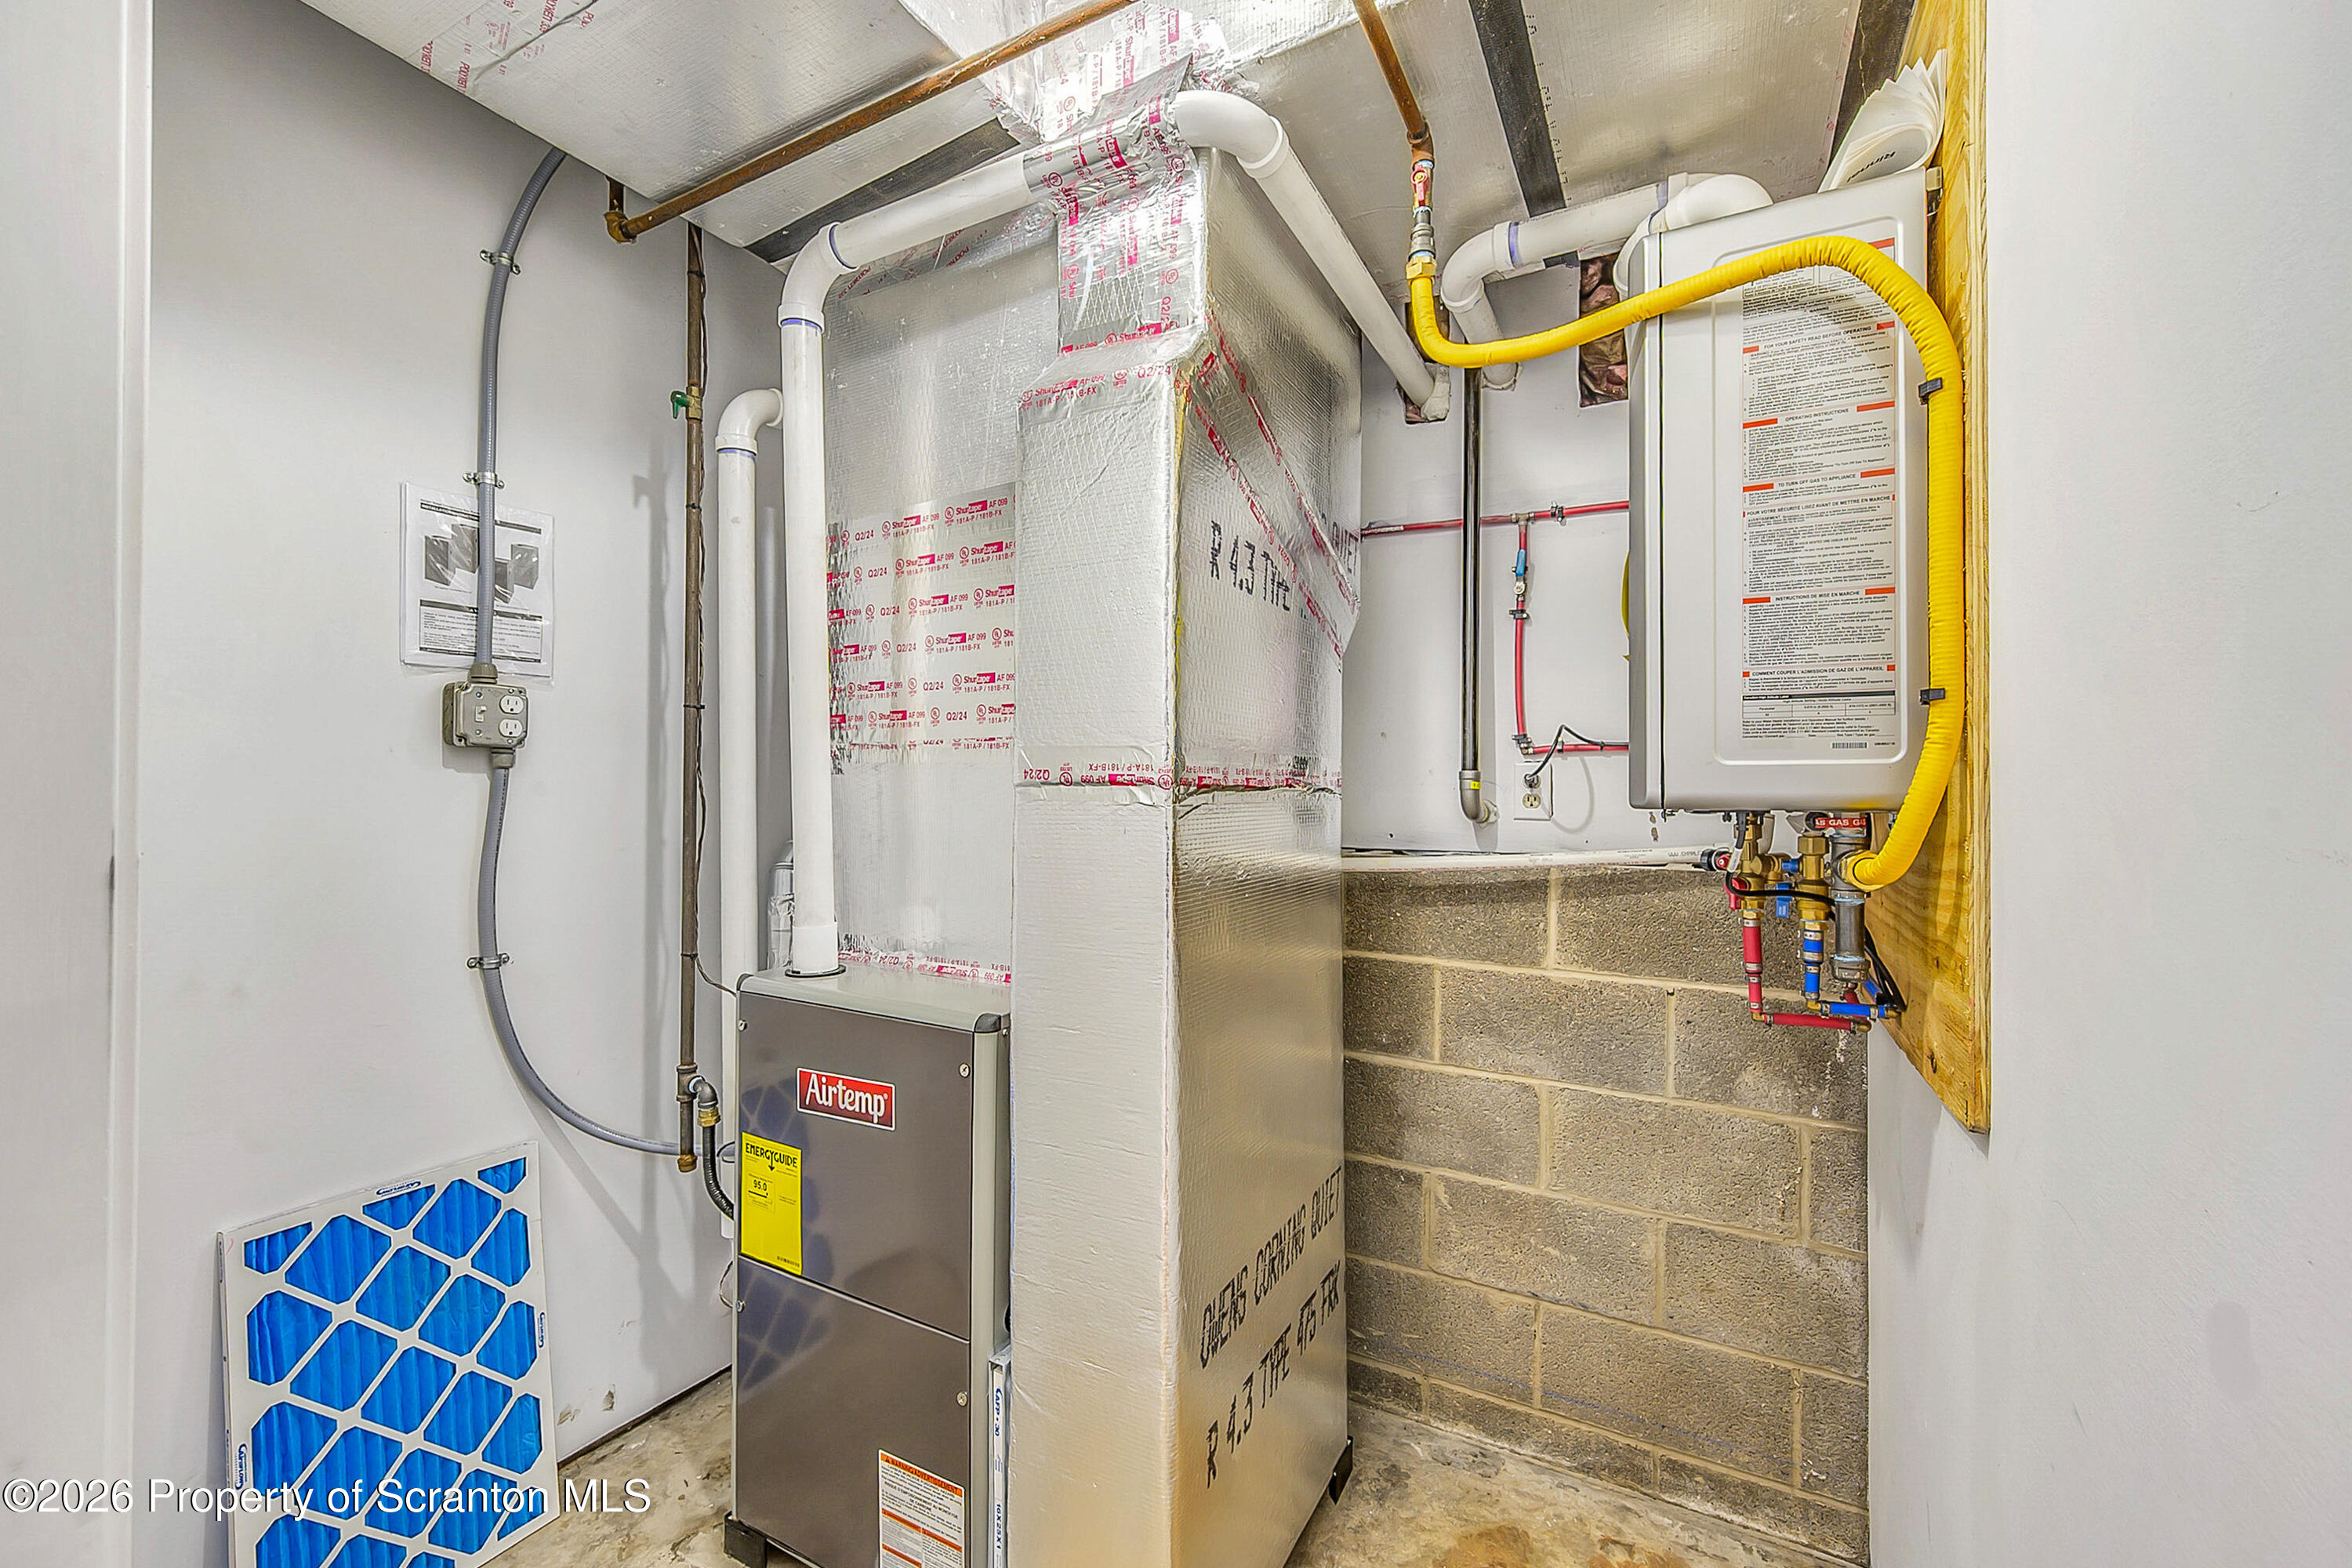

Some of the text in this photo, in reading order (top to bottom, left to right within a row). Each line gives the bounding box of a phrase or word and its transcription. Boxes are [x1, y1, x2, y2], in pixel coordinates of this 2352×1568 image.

[1843, 326, 1871, 335] OPERATING
[1138, 365, 1171, 379] Q2/24
[1813, 408, 1849, 418] INSTRUCTIONS
[956, 500, 987, 515] Shurtape
[998, 498, 1007, 506] 099
[855, 530, 874, 541] Q2/24
[971, 541, 1004, 555] Shurtape
[995, 552, 1015, 563] 181B-F
[868, 567, 887, 578] Q2/24
[880, 606, 900, 616] Q2/24
[896, 643, 916, 653] Q2/24
[963, 672, 996, 684] Shurtape
[923, 681, 944, 691] Q2/24
[946, 711, 967, 721] Q2/24
[1088, 763, 1154, 771] 181A-P 181B-FX
[1024, 769, 1050, 780] Q2/24
[1080, 775, 1094, 783] 099
[806, 1073, 887, 1123] Airtemp
[746, 1143, 798, 1168] ENERGYGUIDE
[753, 1179, 768, 1192] 95.0
[1200, 1166, 1342, 1369] OWENS CORNING QUIET
[1207, 1421, 1218, 1489] R
[1259, 1323, 1292, 1410] TYPE
